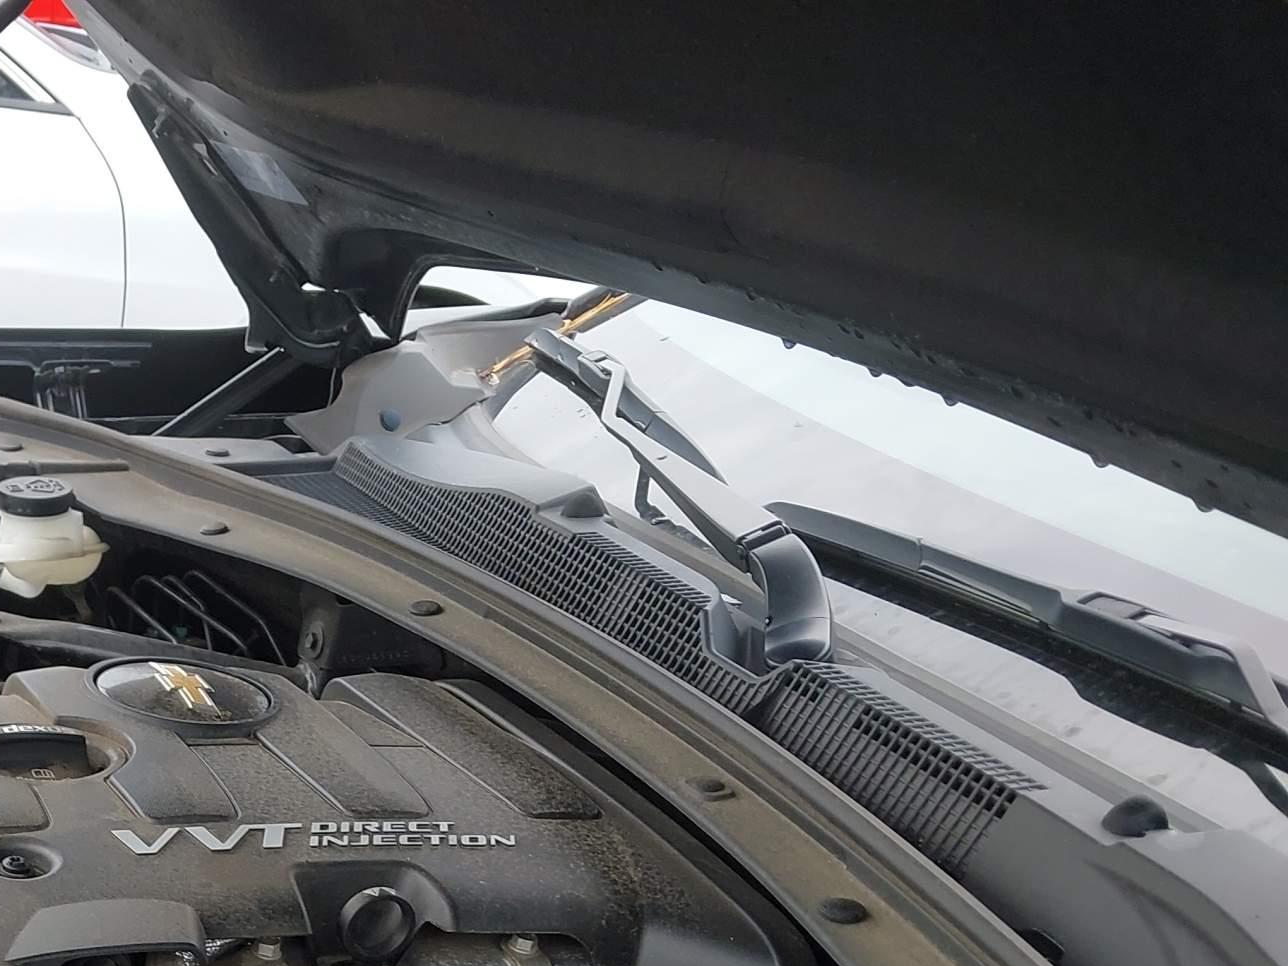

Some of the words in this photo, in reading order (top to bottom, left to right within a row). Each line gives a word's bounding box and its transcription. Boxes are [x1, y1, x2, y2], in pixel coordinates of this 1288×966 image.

[110, 822, 302, 855] VVT
[310, 821, 456, 834] DIRECT
[309, 833, 517, 848] INJECTION
